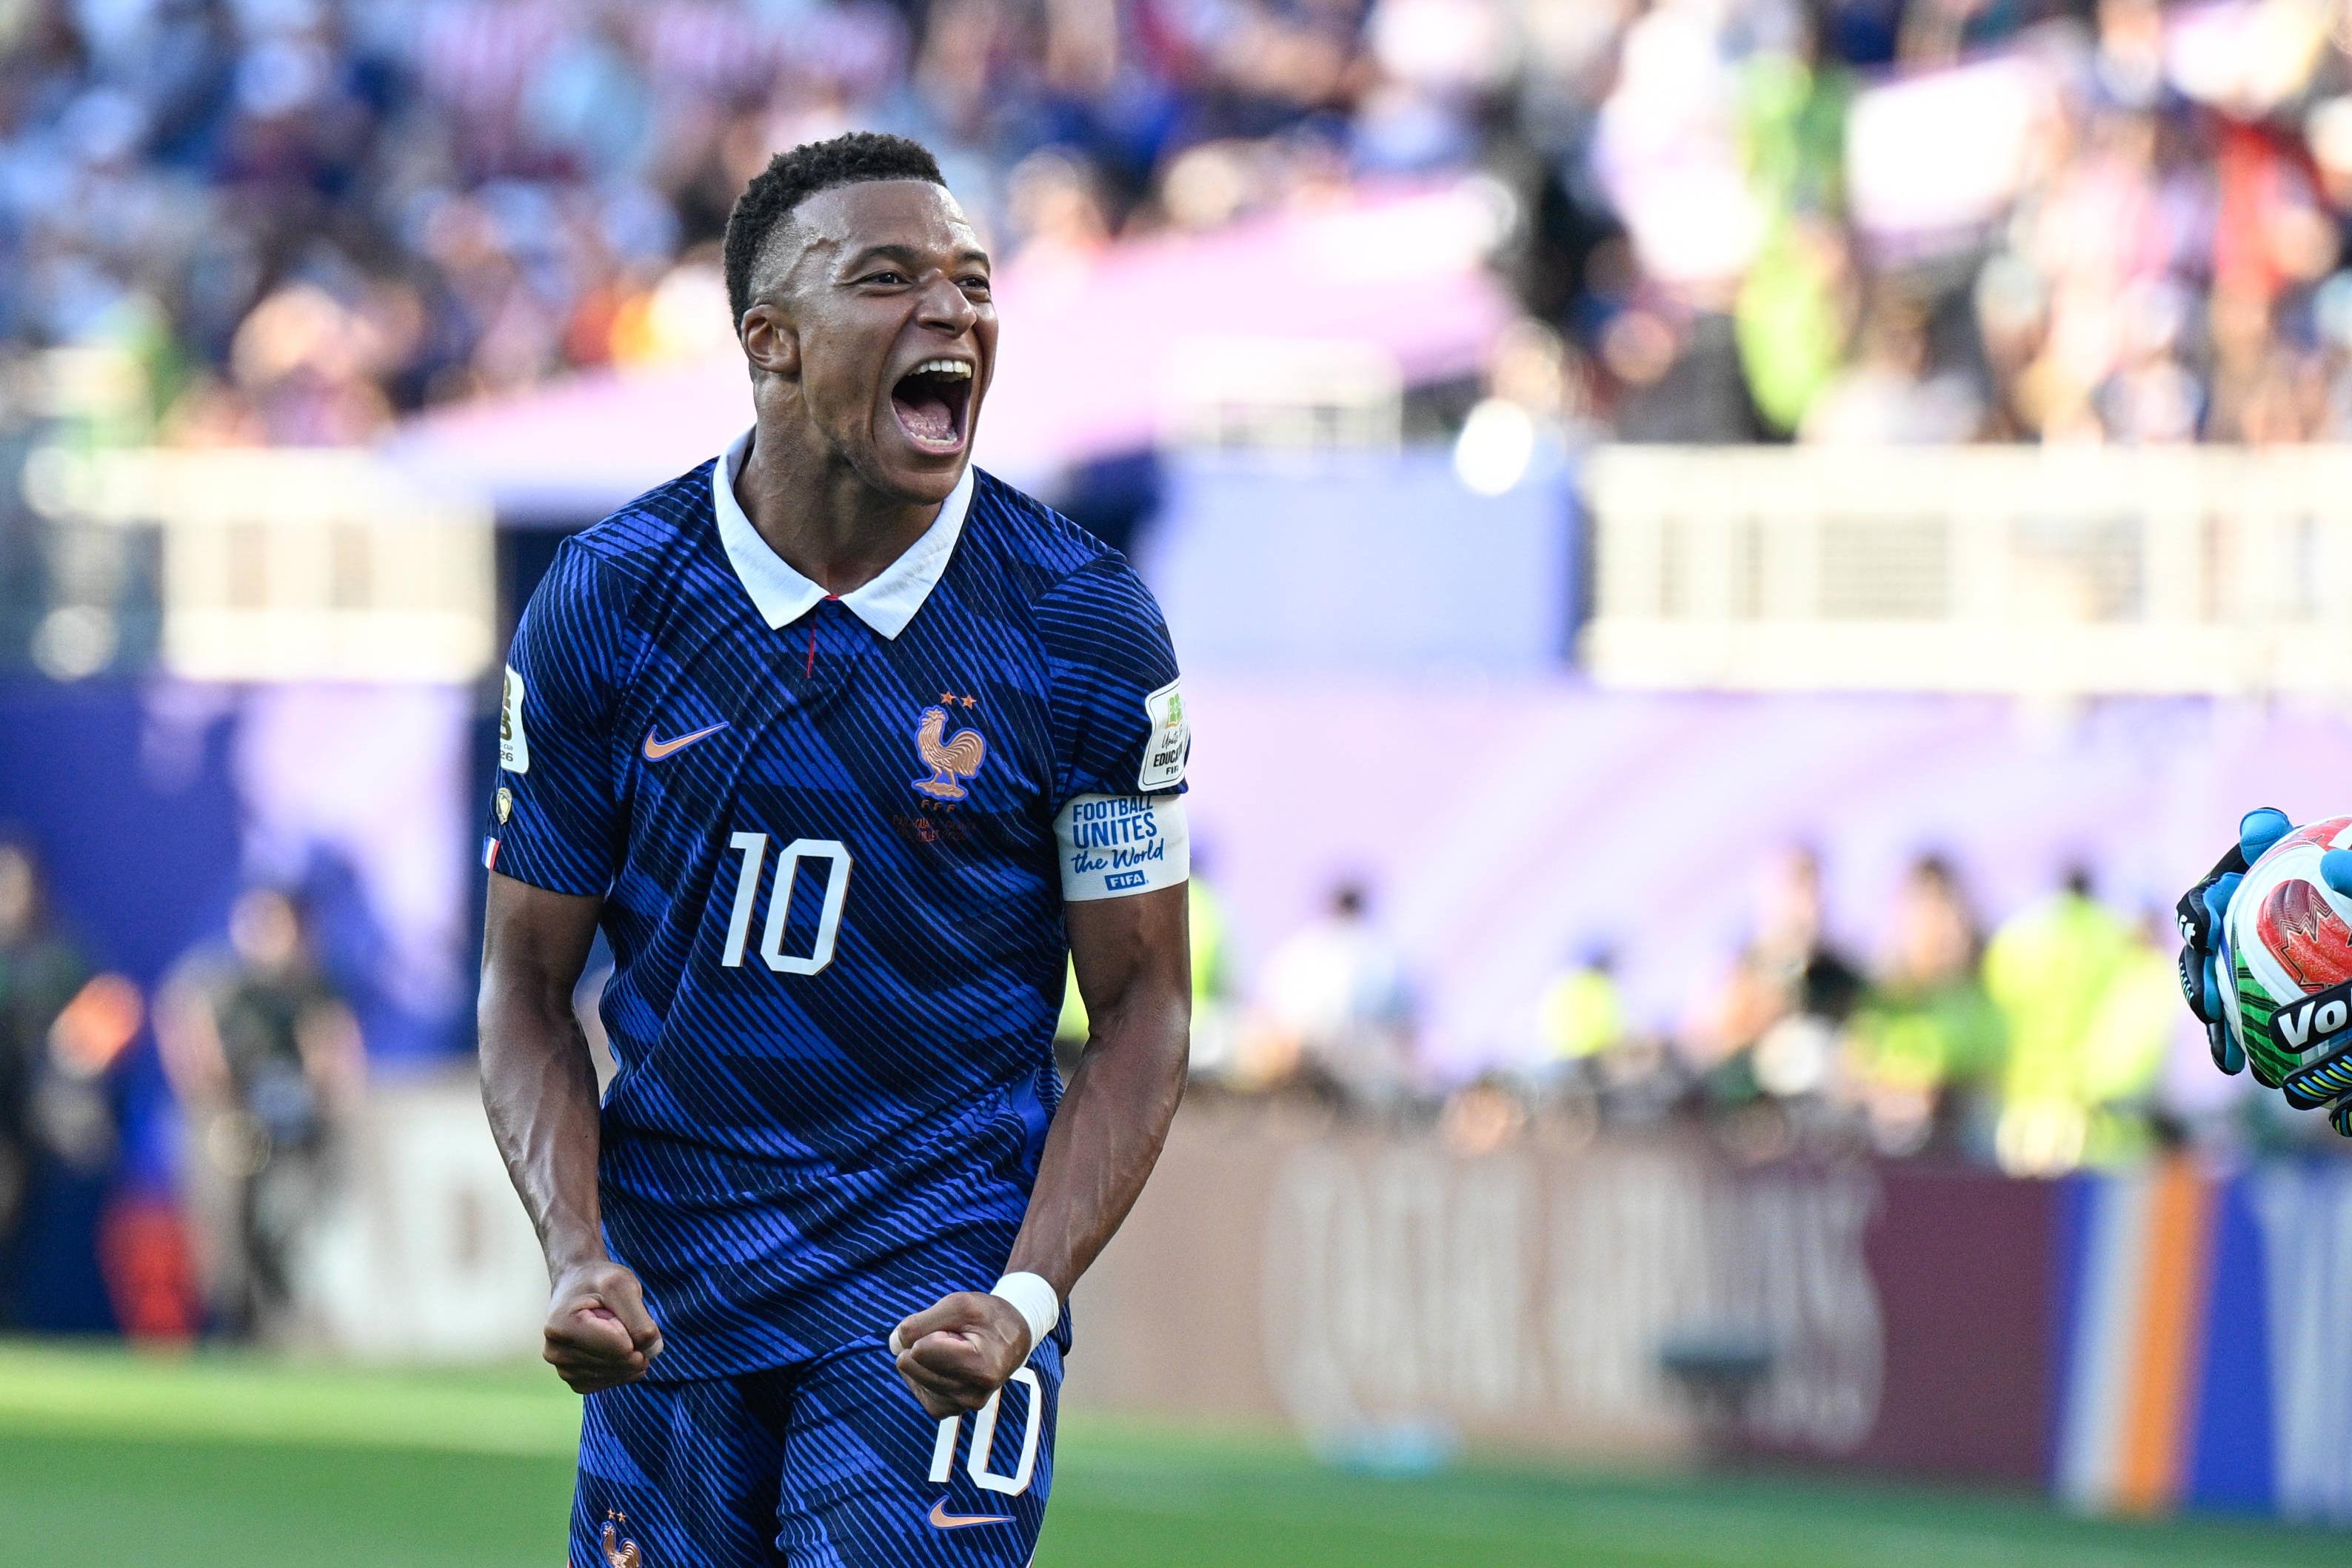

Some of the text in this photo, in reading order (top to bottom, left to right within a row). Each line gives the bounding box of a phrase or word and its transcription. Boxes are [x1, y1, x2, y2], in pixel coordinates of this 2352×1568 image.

[1166, 764, 1179, 775] FIF
[1073, 794, 1154, 822] FOOTBALL
[1073, 812, 1157, 849] UNITES
[1071, 837, 1163, 874] the World
[1109, 874, 1143, 888] FIFA
[721, 831, 854, 976] 10
[2278, 988, 2352, 1048] Vo
